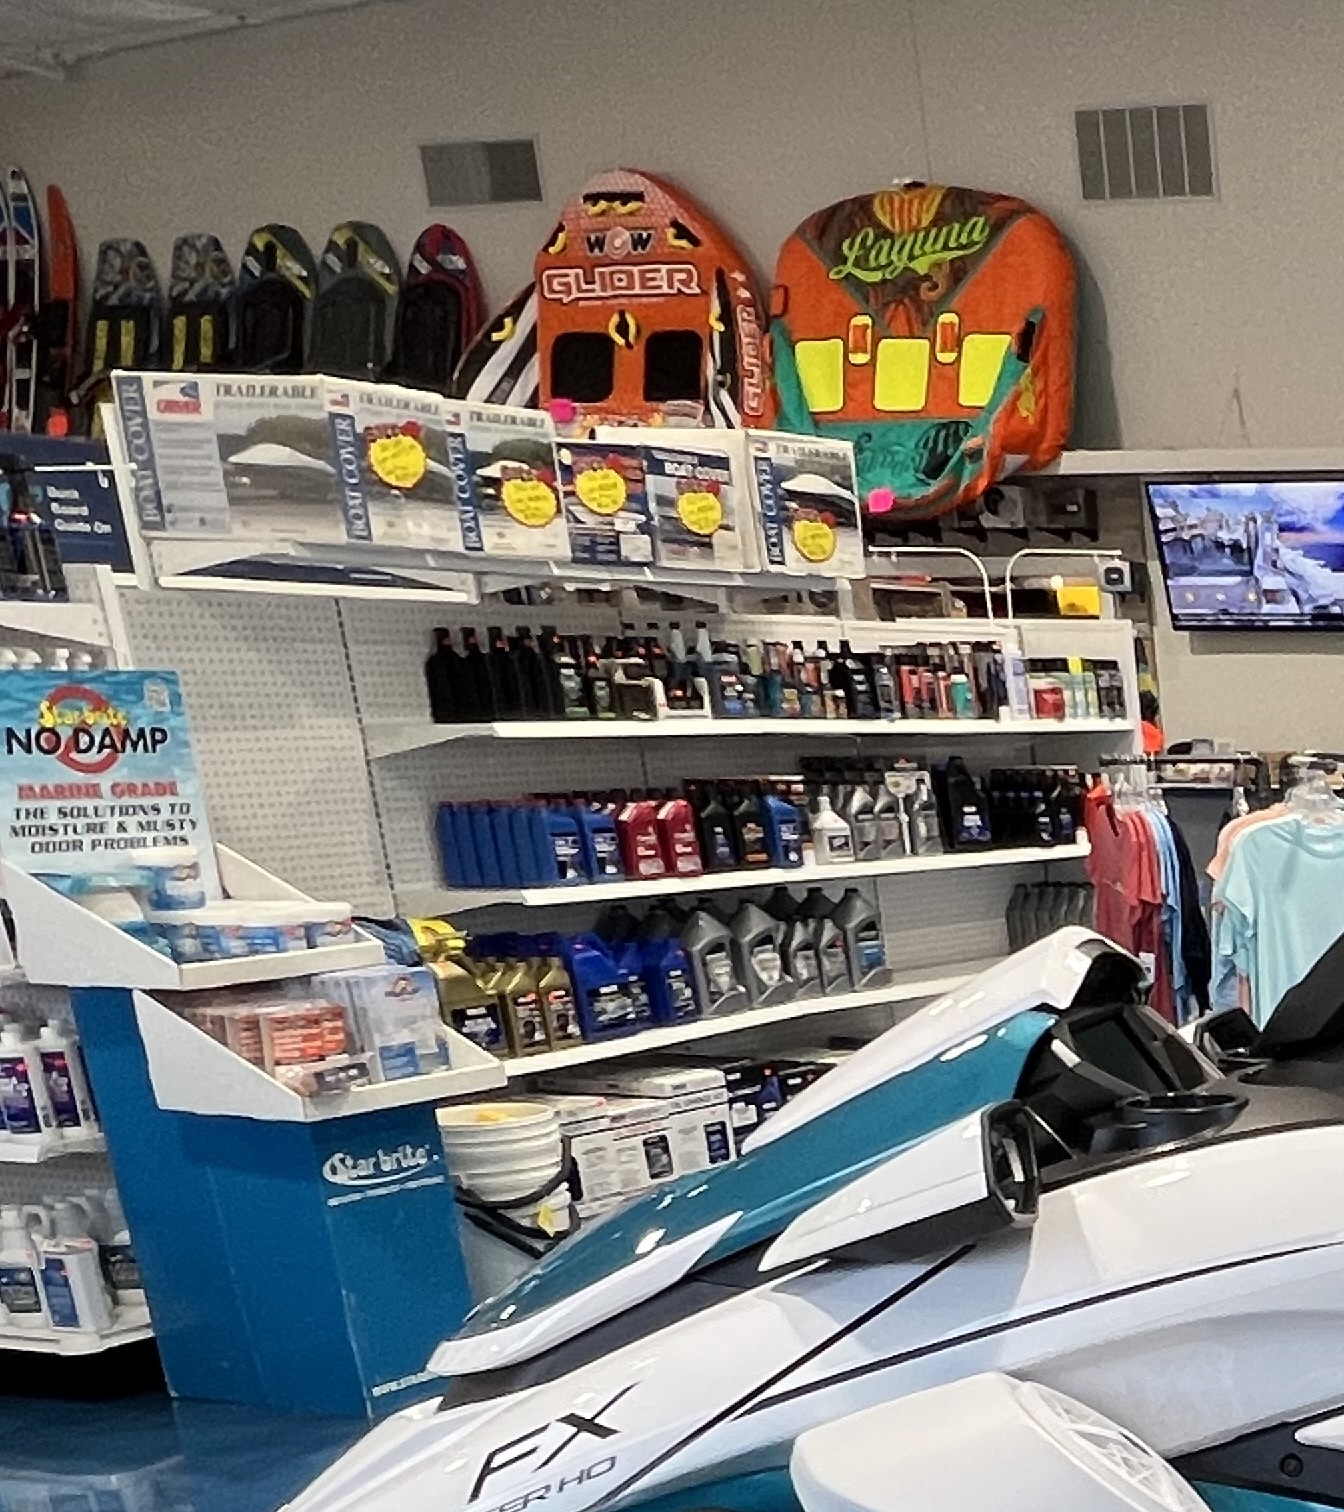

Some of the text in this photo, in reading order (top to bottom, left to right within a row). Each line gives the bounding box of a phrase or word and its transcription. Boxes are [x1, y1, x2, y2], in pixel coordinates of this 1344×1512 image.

[586, 227, 654, 259] WOW
[829, 216, 990, 283] Laguna
[542, 264, 702, 304] GLIDER
[216, 382, 319, 399] TRAILERABLE
[121, 382, 162, 522] BOAT COVER
[448, 435, 472, 500] COVER
[334, 416, 369, 540] BOAT COVER
[6, 726, 168, 755] NO DAMP
[18, 780, 179, 801] MARINE GRADE
[9, 818, 199, 839] MOISTURE & MUSTY
[14, 802, 192, 821] THE SOLUTIONS TO
[30, 835, 190, 854] ODOR PROBLEMS
[467, 1380, 642, 1504] FX
[556, 1455, 618, 1493] HO
